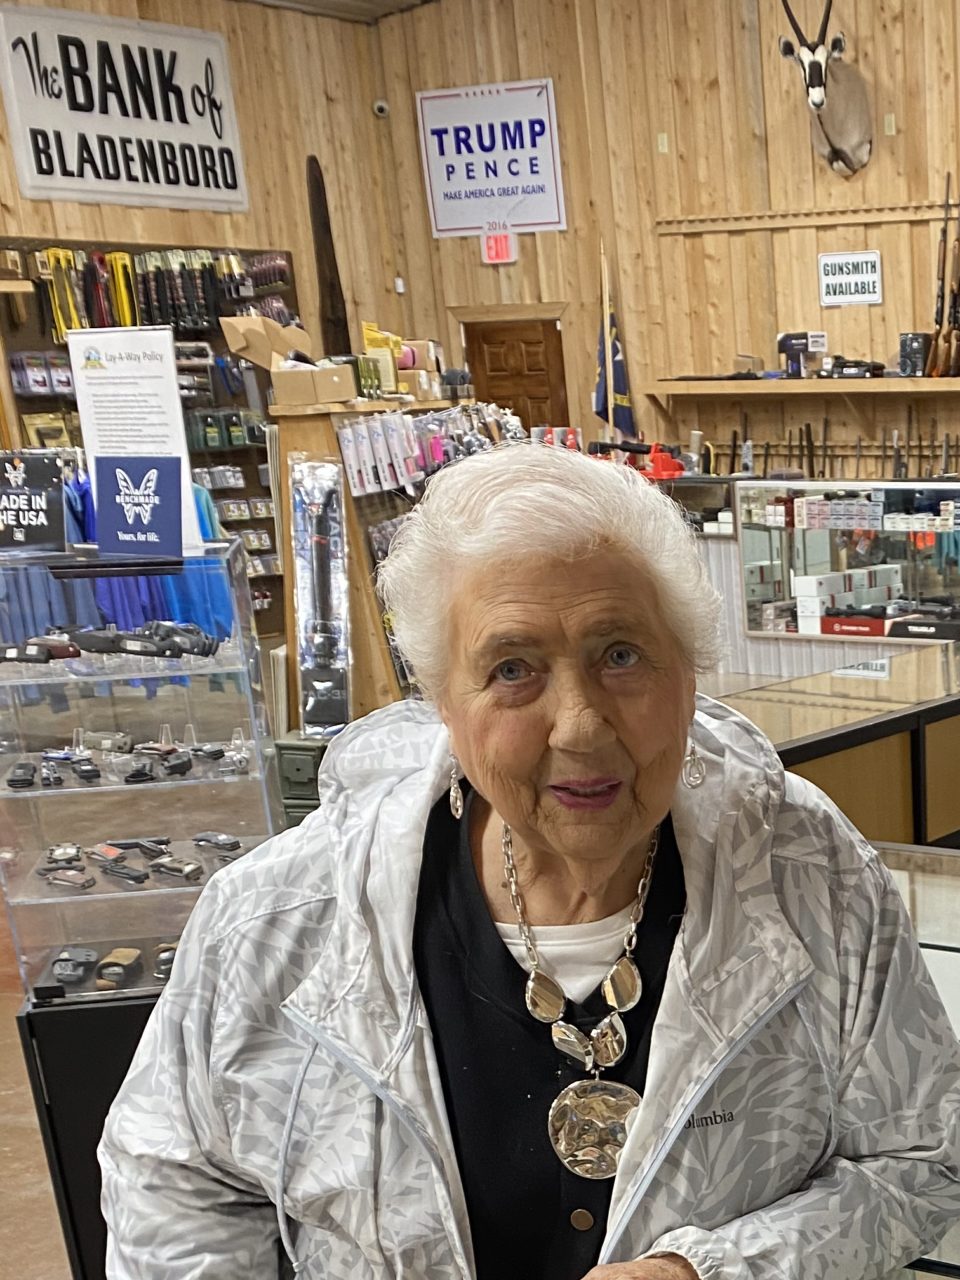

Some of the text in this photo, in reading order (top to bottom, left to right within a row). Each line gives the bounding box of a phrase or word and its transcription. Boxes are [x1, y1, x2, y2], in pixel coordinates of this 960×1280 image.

[57, 34, 189, 124] BANK
[191, 57, 222, 139] of
[430, 118, 546, 156] TRUMP
[29, 127, 238, 189] BLADENBORO
[446, 156, 540, 181] PENCE
[443, 184, 546, 200] MAKE AMERICA GREAT AGAIN!
[486, 221, 508, 230] 2016
[487, 235, 511, 260] EXIT
[823, 260, 877, 276] GUNSMITH
[825, 281, 877, 296] AVAILABLE
[105, 351, 163, 364] Lay-A-Way Policy
[32, 494, 47, 510] IN
[19, 511, 48, 526] USA
